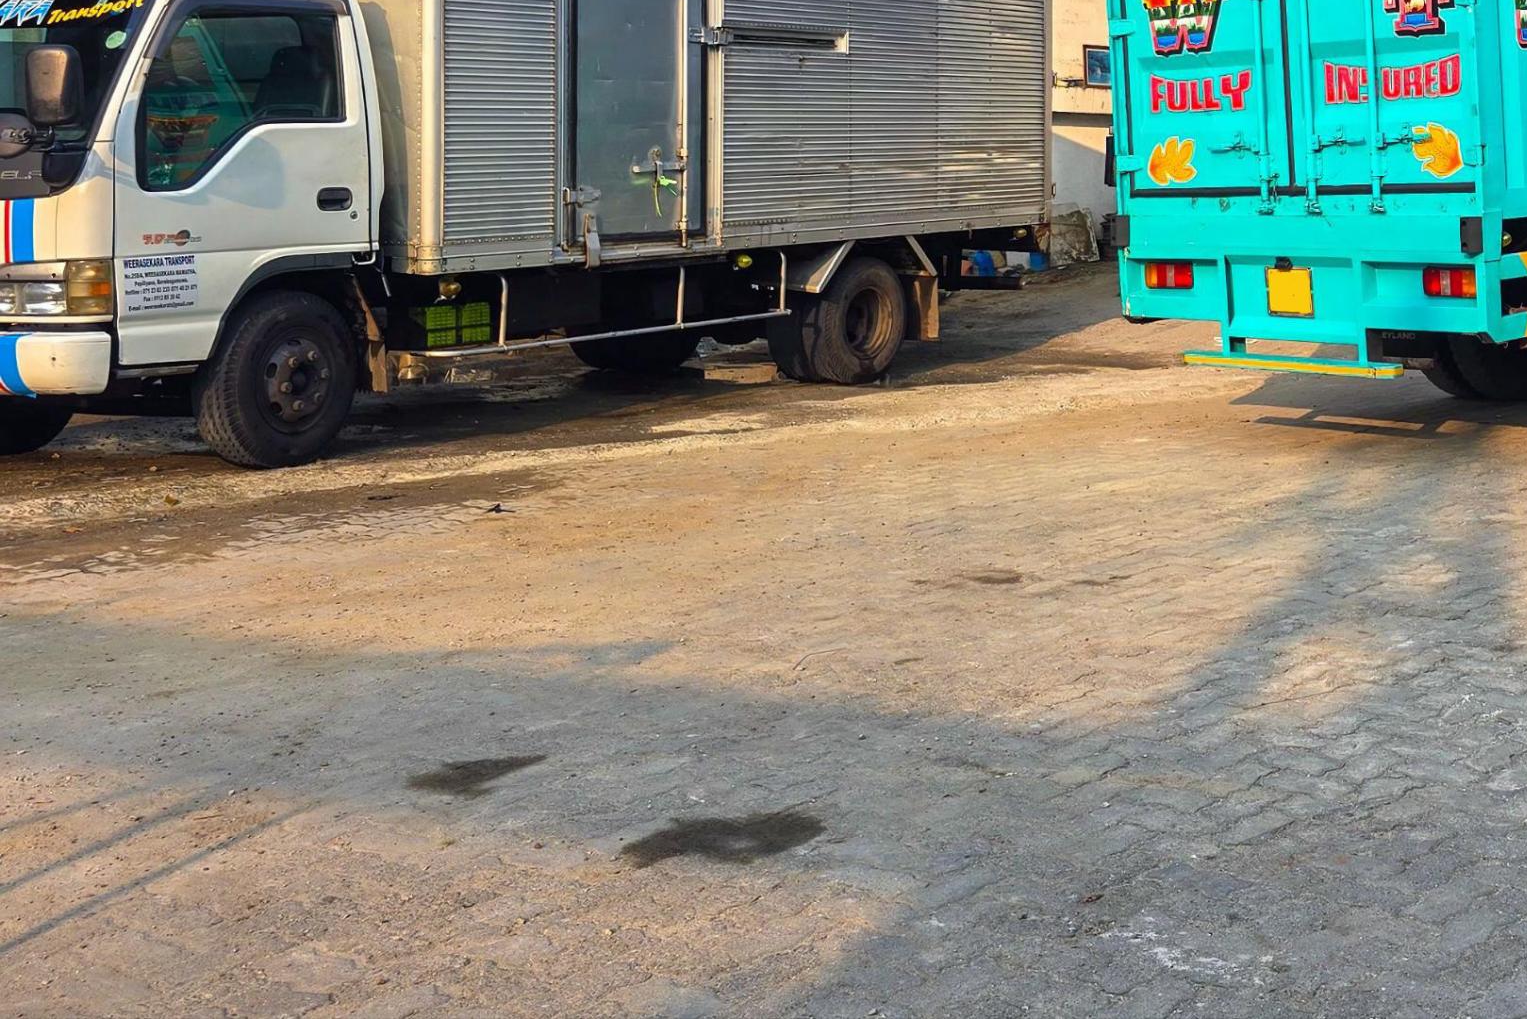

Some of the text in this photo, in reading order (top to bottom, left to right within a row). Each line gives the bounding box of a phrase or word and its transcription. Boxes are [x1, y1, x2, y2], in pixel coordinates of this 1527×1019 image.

[1150, 67, 1251, 114] FULLY
[123, 255, 195, 269] WEERASEKARA TRANSPORT
